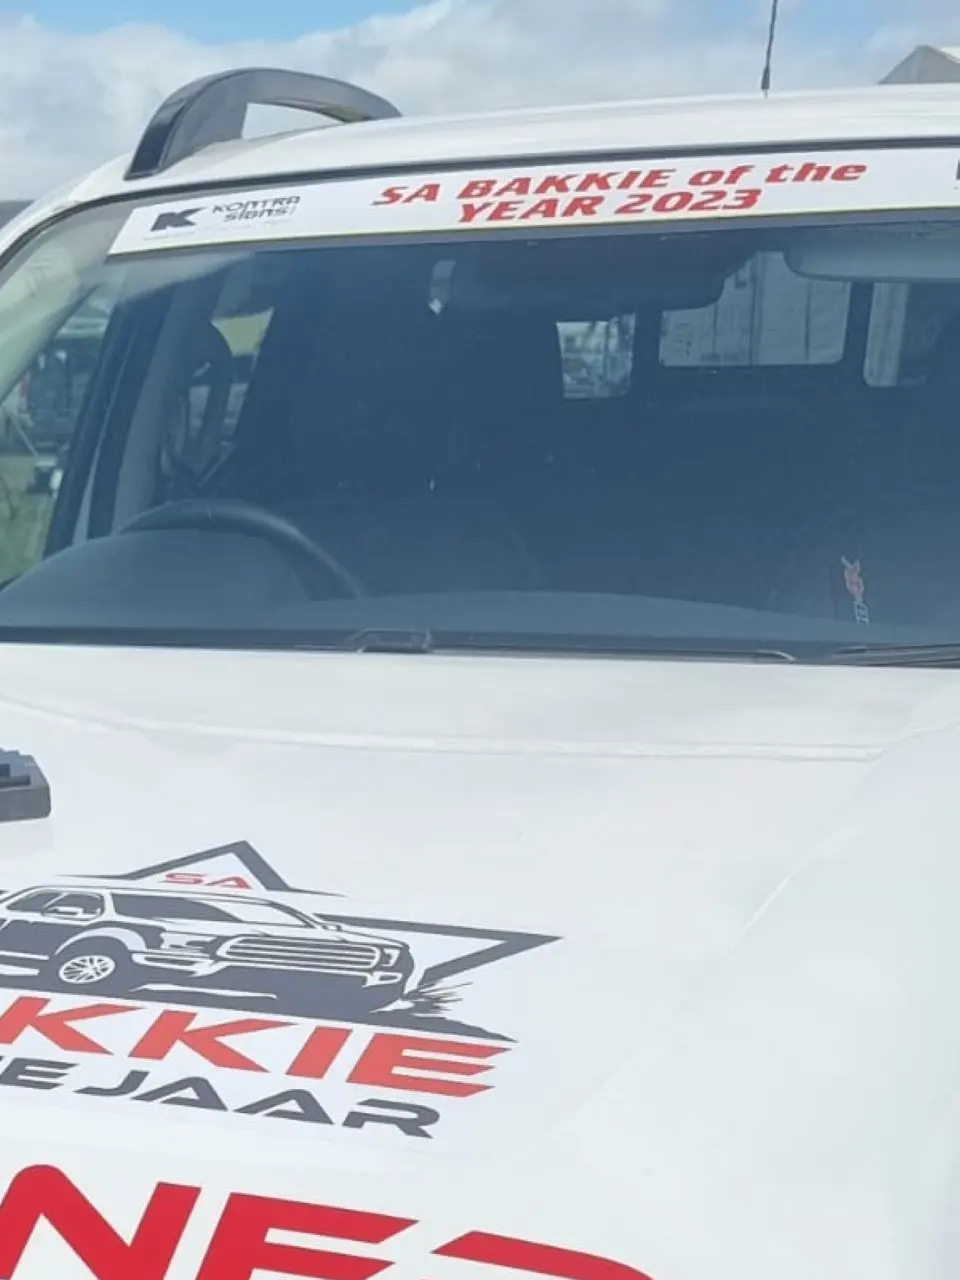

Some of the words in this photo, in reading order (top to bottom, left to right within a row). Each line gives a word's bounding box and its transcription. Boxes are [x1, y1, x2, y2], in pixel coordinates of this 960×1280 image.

[373, 183, 441, 206] SA
[456, 168, 677, 199] BAKKIE
[687, 164, 756, 186] of
[765, 162, 868, 183] the
[458, 195, 605, 223] YEAR
[613, 188, 762, 214] 2023
[158, 873, 252, 889] SA
[74, 1070, 442, 1140] JAAR
